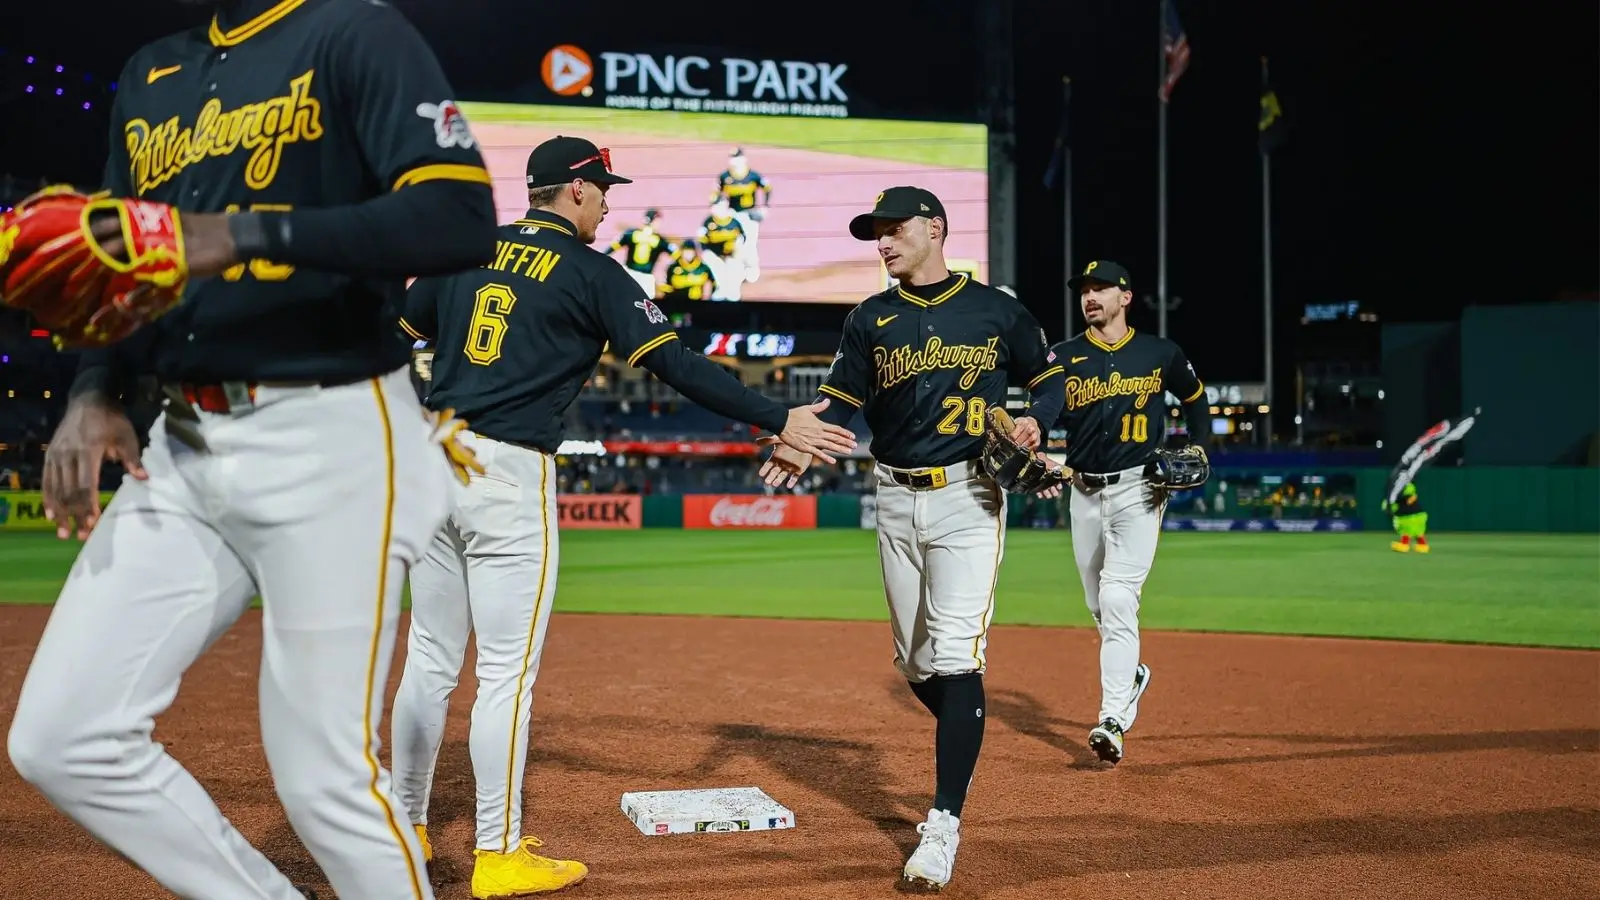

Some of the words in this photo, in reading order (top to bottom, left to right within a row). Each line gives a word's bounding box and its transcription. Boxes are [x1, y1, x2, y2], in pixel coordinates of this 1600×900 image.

[601, 52, 710, 96] PNC
[721, 58, 848, 101] PARK
[124, 69, 324, 196] Pittsburgh
[463, 283, 517, 366] 6
[873, 336, 1000, 396] Pittsburgh
[1065, 368, 1161, 410] Pittsburgh
[936, 396, 987, 436] 28
[1120, 413, 1148, 443] 10
